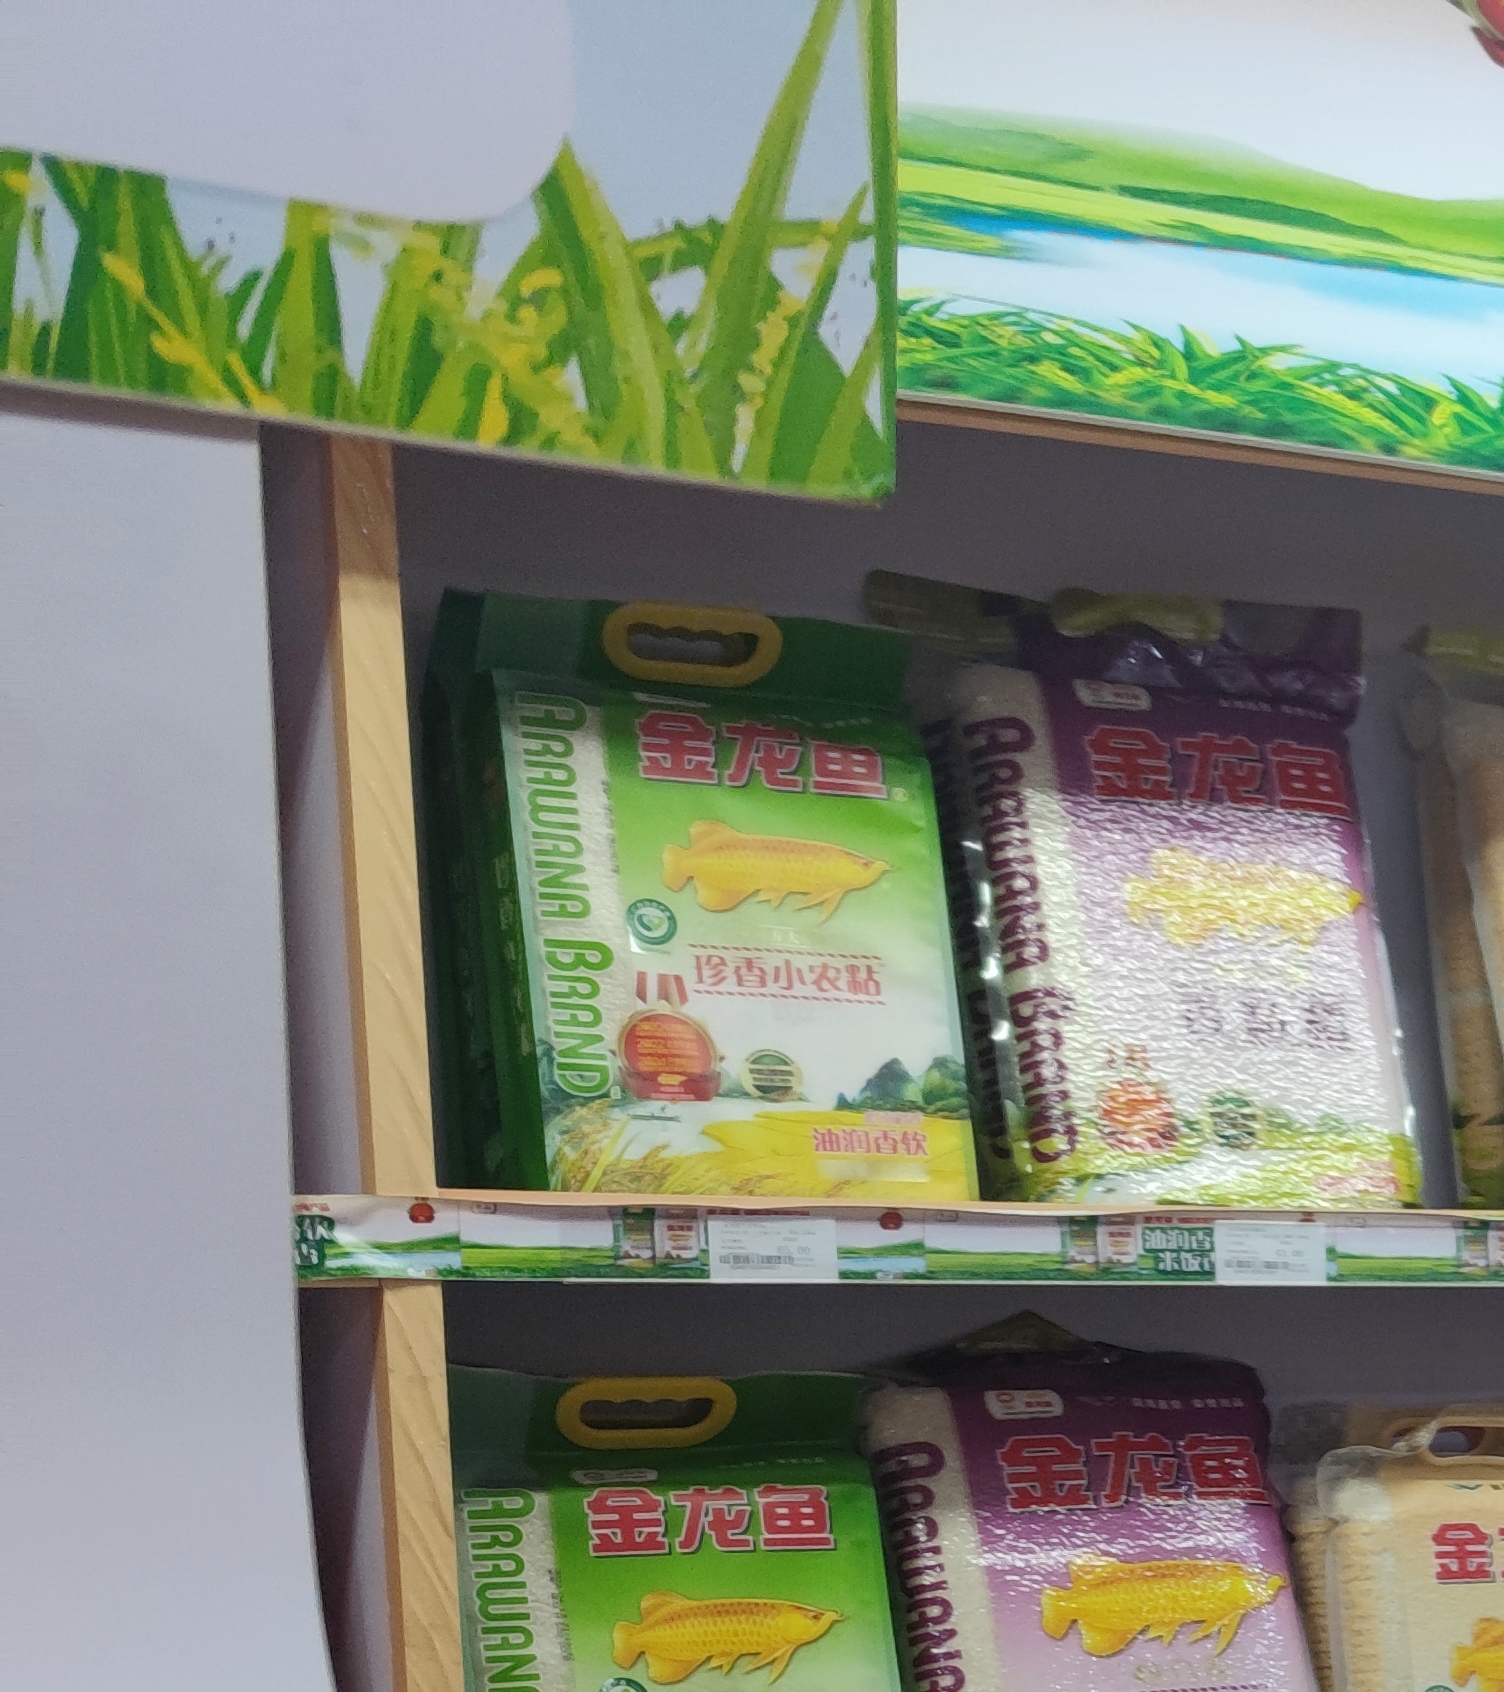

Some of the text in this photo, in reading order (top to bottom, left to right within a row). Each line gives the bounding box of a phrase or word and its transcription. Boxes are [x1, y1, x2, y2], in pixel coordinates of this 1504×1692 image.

[633, 707, 890, 801] 金龙鱼
[1087, 724, 1355, 822] 金龙鱼
[514, 690, 615, 1099] ARAWANA BRAND
[690, 952, 884, 999] 珍香小农粘
[997, 1432, 1272, 1513] 金龙鱼
[582, 1484, 837, 1560] 金龙鱼
